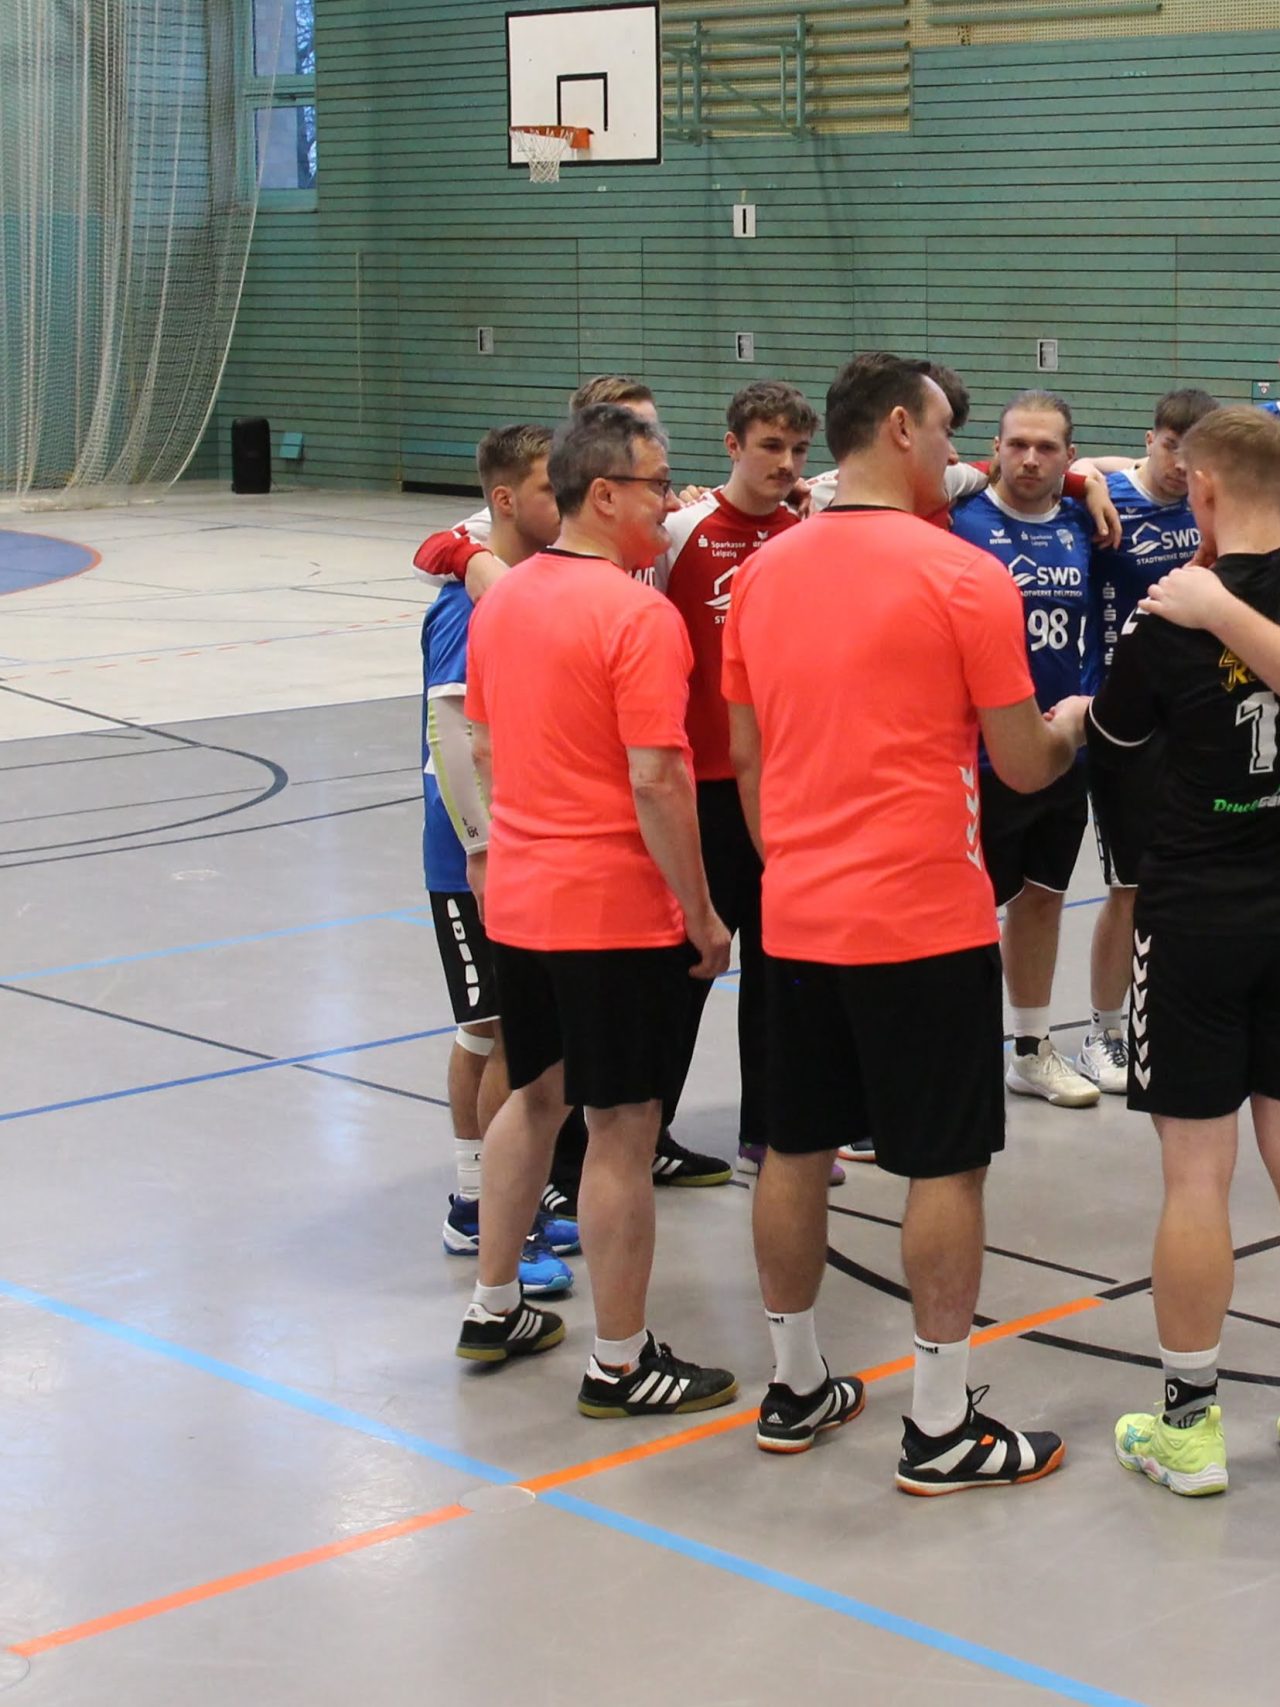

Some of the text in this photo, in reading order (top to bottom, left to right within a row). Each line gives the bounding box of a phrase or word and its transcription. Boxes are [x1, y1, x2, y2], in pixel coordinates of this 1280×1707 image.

[711, 541, 746, 549] Sparkasse
[1161, 527, 1202, 550] SWD
[711, 549, 737, 558] Leipzig
[1036, 566, 1082, 586] SWD
[1027, 607, 1069, 651] 98
